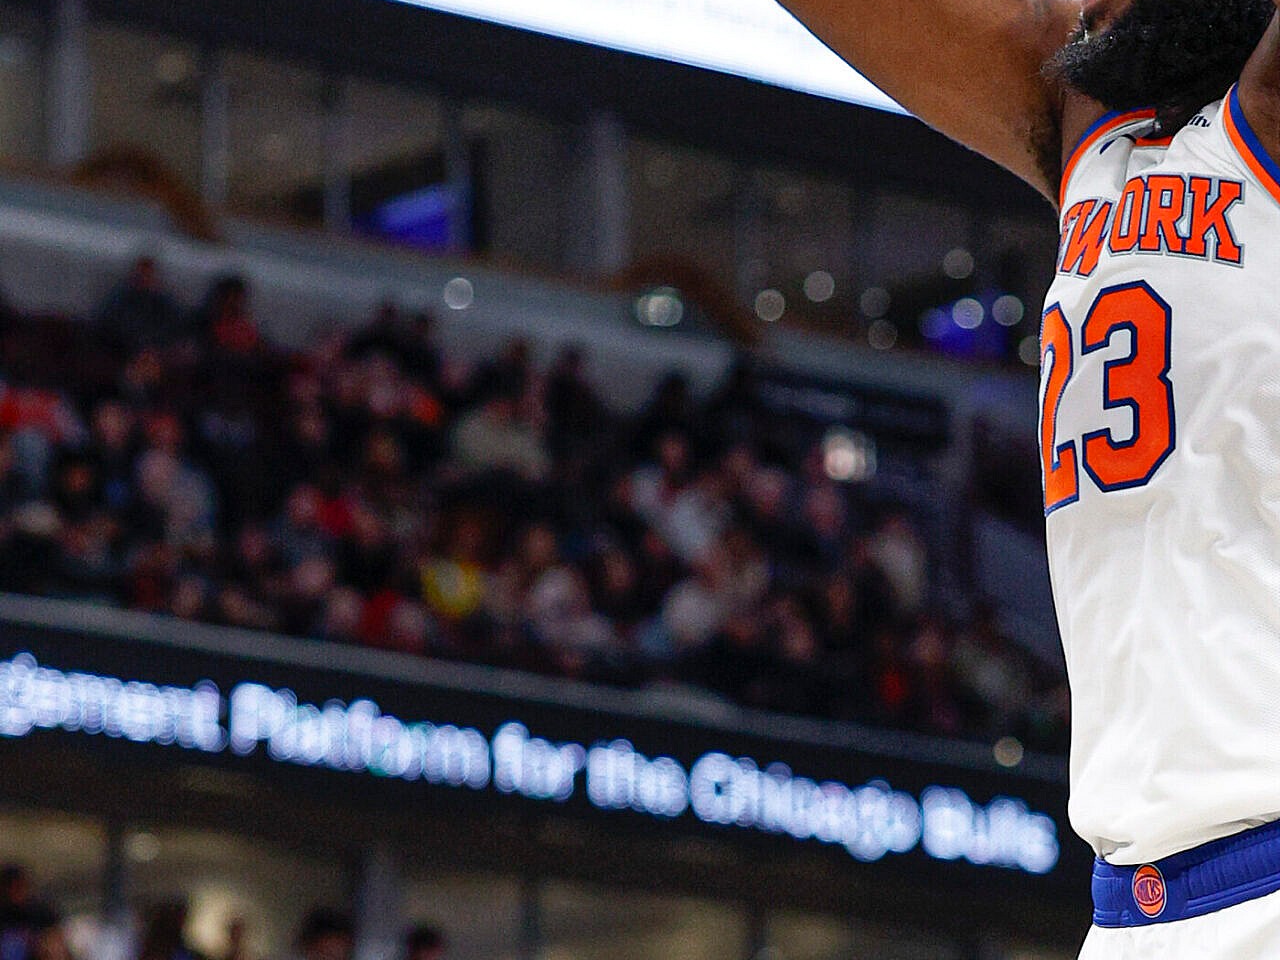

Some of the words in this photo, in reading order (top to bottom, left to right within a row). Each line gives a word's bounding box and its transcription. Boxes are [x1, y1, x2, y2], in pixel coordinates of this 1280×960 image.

[1109, 173, 1246, 266] ORK
[1039, 279, 1176, 518] 23
[491, 722, 587, 802] for
[587, 738, 688, 818] the
[921, 785, 1059, 874] Bulls
